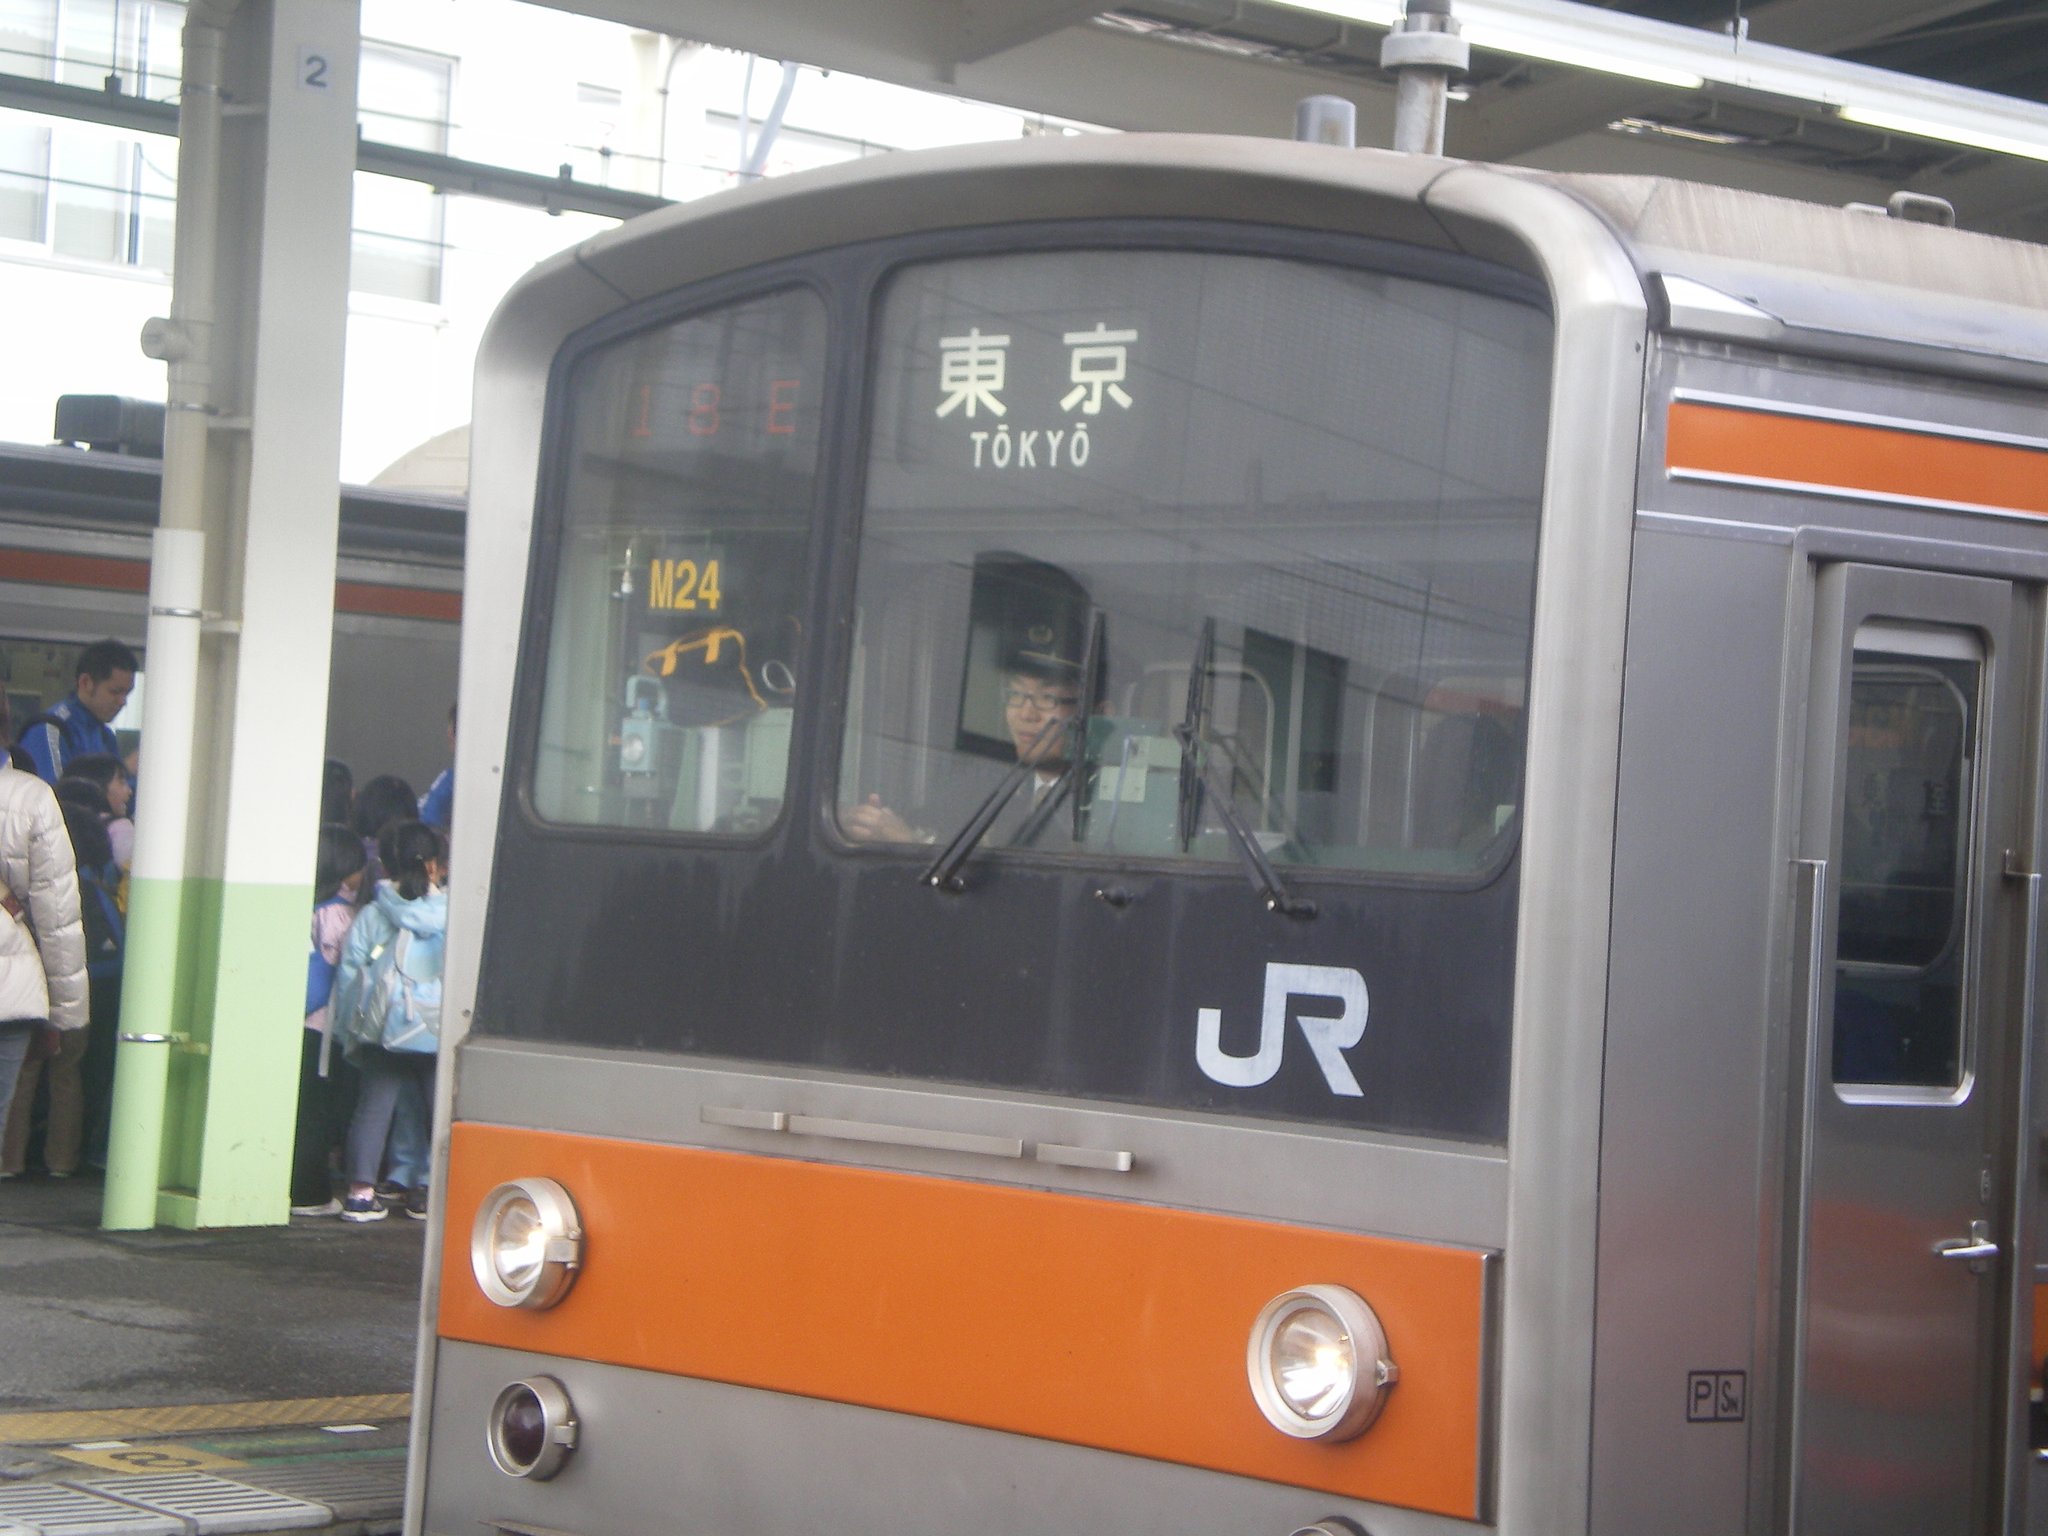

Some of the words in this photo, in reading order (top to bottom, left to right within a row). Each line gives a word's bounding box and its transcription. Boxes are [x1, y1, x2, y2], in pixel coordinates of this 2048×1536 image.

[305, 54, 328, 88] 2
[936, 322, 1138, 418] 東京
[650, 559, 721, 610] M24
[1196, 962, 1369, 1097] JR
